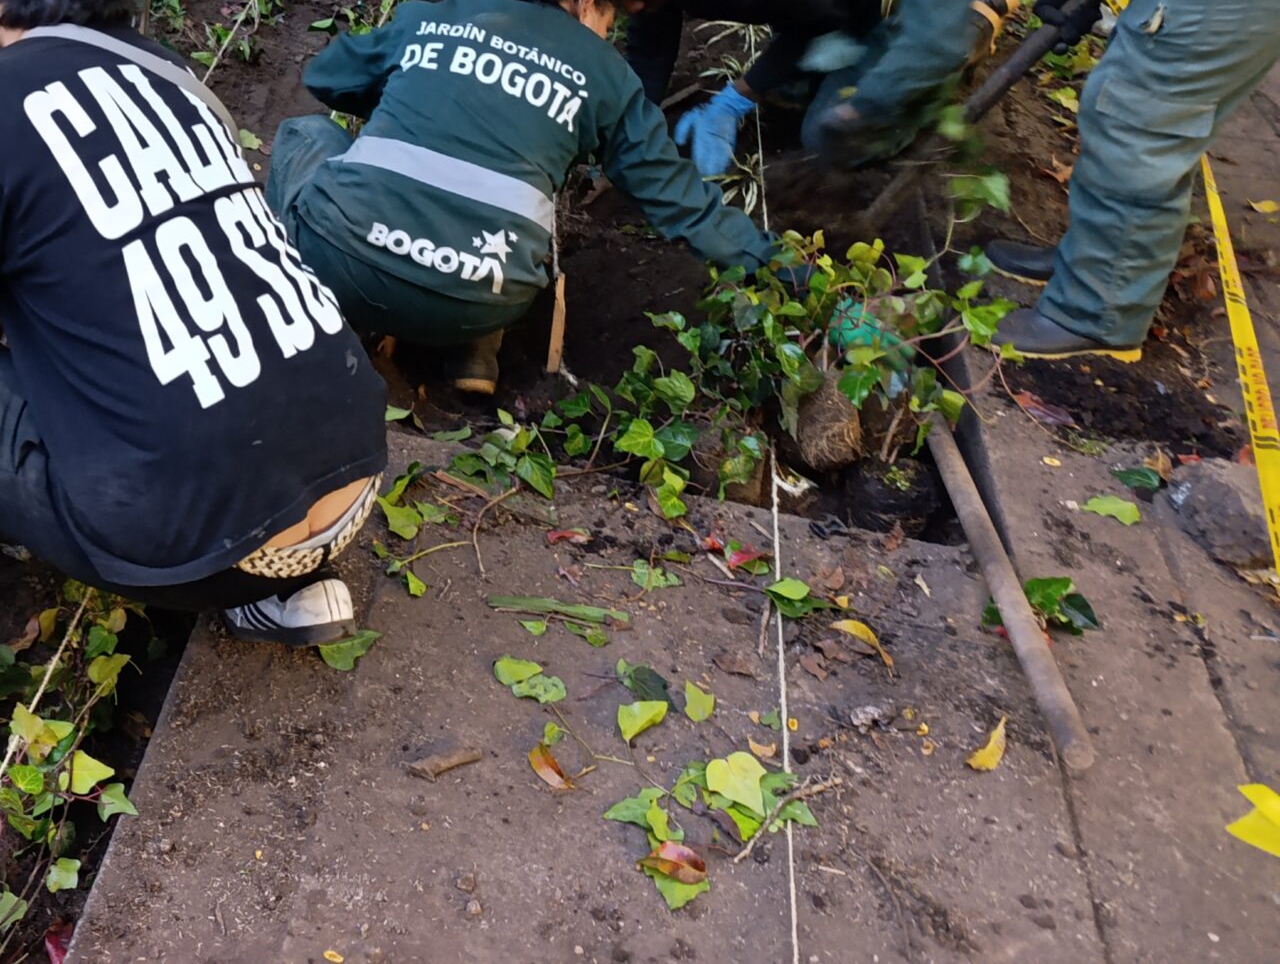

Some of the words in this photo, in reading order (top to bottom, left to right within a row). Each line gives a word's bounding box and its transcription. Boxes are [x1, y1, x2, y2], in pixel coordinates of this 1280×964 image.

[400, 43, 444, 72] DE
[449, 46, 588, 132] BOGOTÁ
[416, 21, 486, 43] JARDÍN
[490, 35, 587, 86] BOTÁNICO
[122, 216, 261, 409] 49
